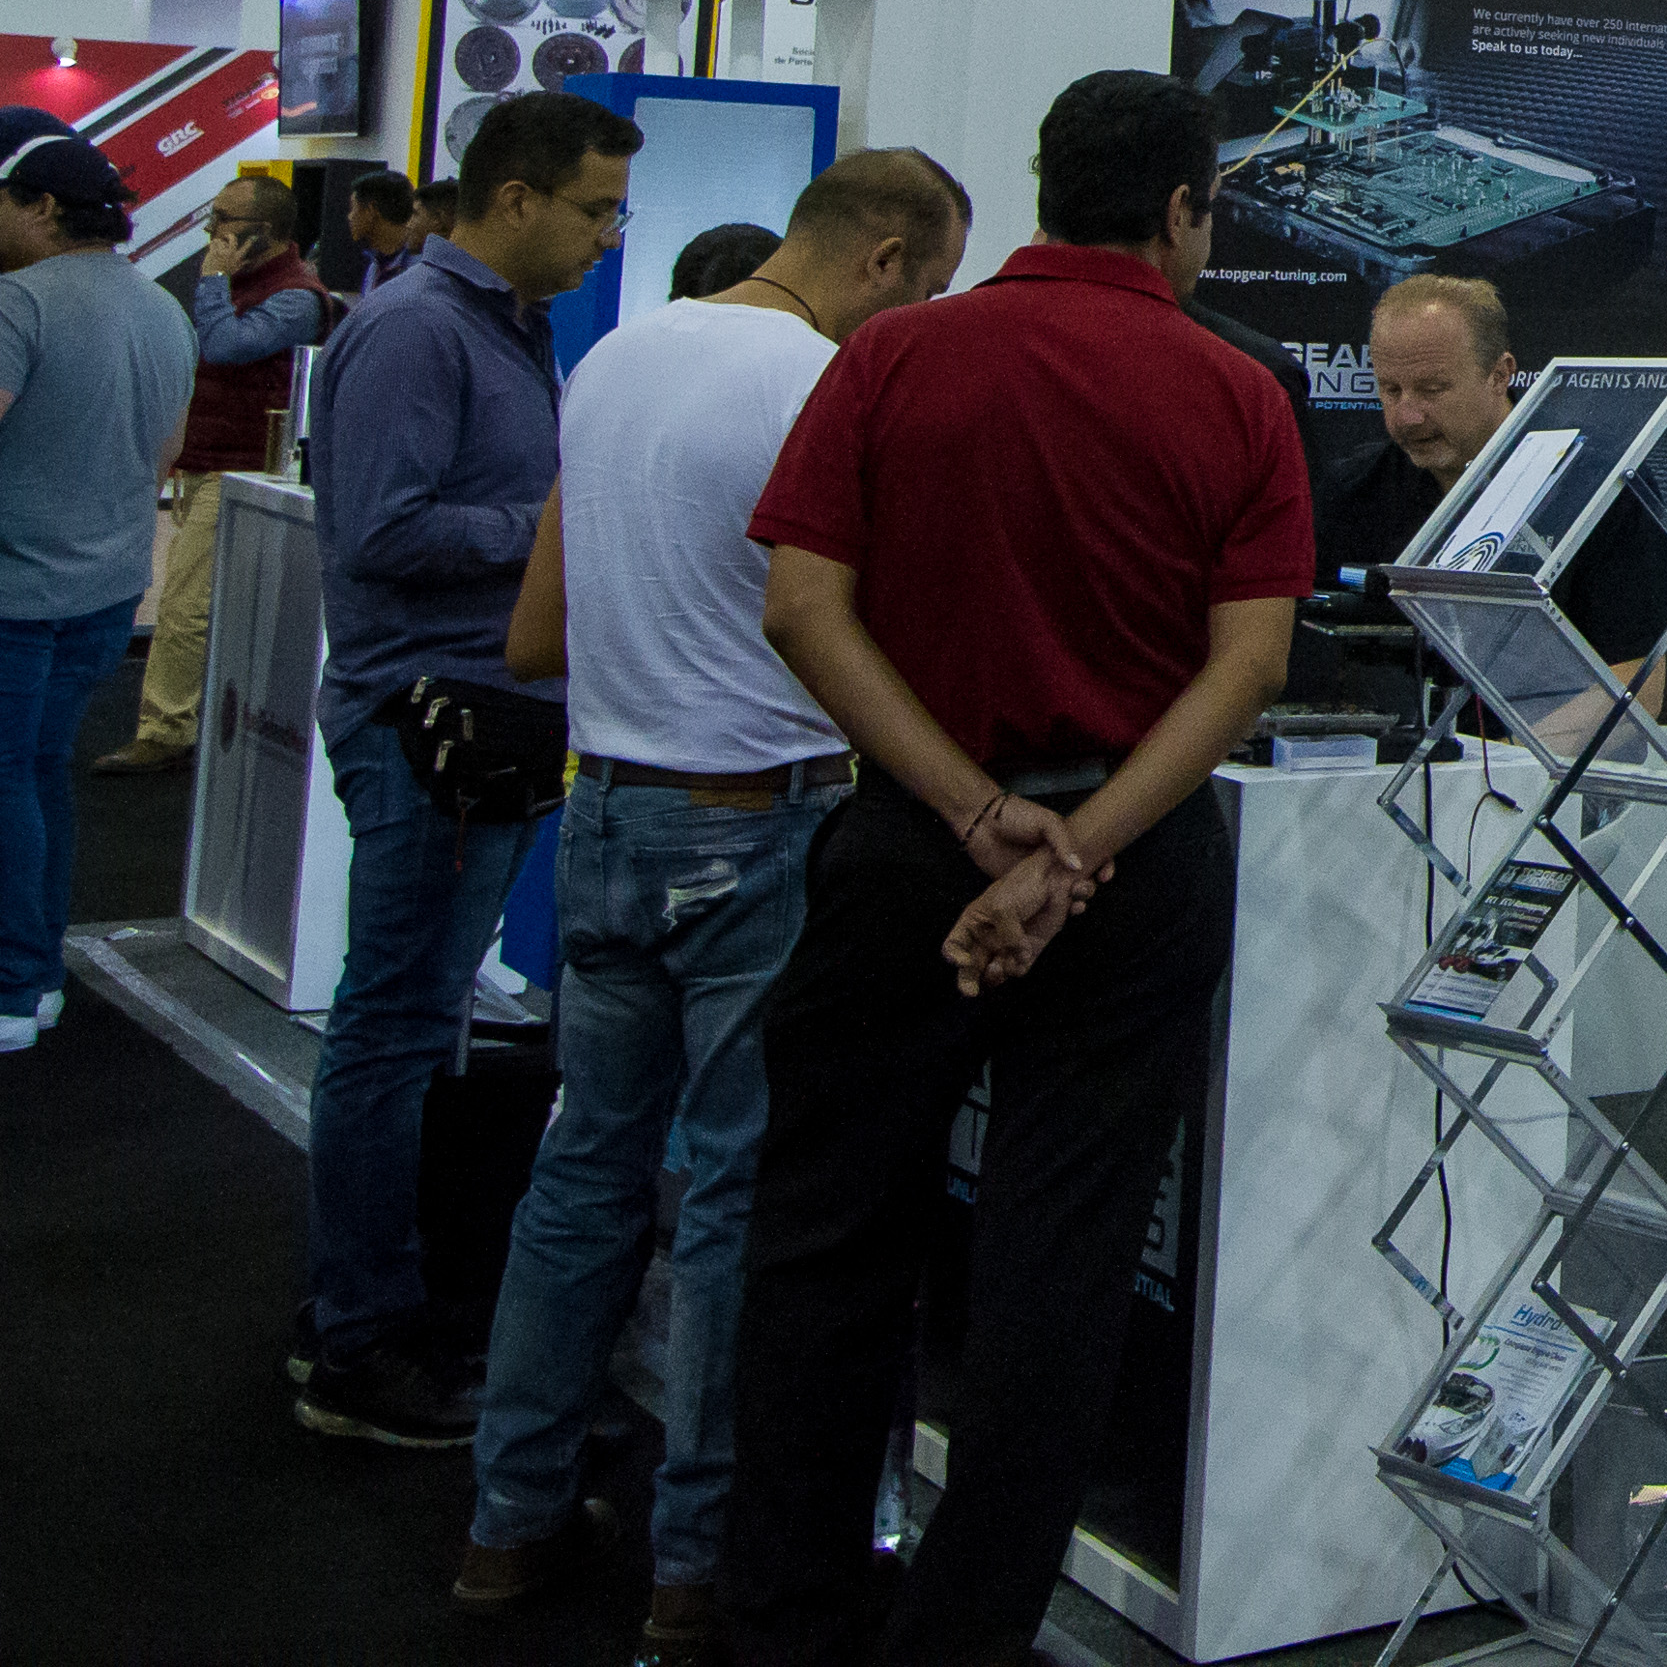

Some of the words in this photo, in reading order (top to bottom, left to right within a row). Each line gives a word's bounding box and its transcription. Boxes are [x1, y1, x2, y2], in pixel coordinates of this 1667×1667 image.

[1473, 8, 1491, 20] We
[1494, 9, 1544, 27] currently
[1547, 13, 1573, 26] have
[1576, 18, 1600, 29] over
[1603, 18, 1623, 30] 250
[1472, 25, 1491, 36] are
[1494, 24, 1534, 41] actively
[1537, 28, 1579, 45] seeking
[1582, 32, 1605, 44] new
[1608, 33, 1664, 49] individuals
[1471, 39, 1507, 56] Speak
[1509, 42, 1521, 54] to
[1525, 44, 1537, 55] us
[1567, 372, 1631, 389] AGENTS
